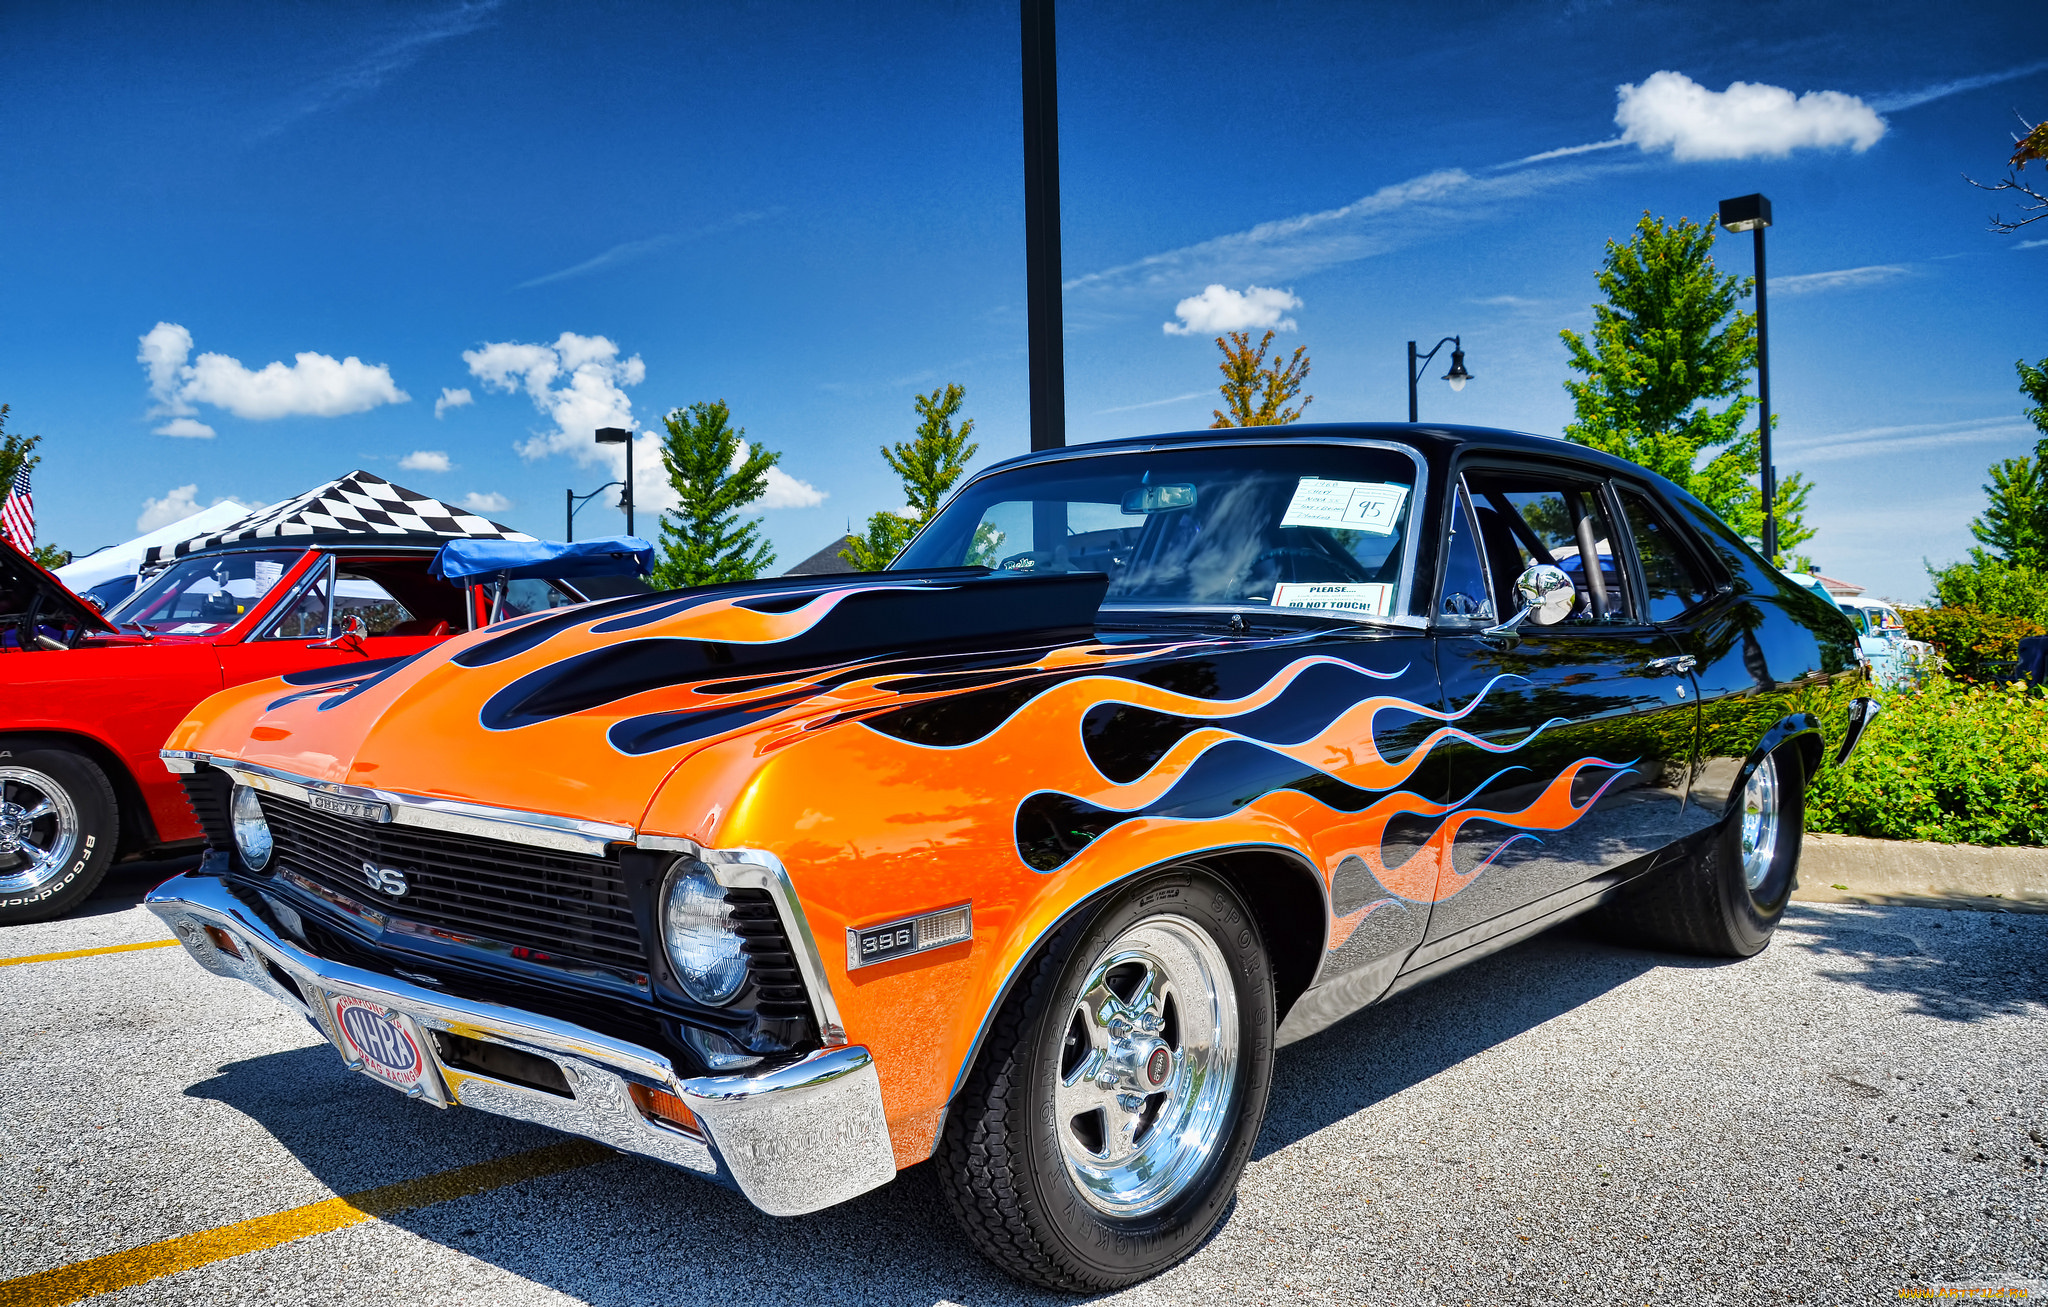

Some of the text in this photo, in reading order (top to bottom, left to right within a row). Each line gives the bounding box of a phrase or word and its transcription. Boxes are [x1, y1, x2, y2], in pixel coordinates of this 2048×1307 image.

[1358, 500, 1385, 519] 95
[1306, 601, 1329, 609] NOT
[1330, 601, 1371, 611] TOUCH!
[315, 797, 358, 815] CHEVY
[362, 862, 409, 897] SS
[862, 928, 911, 955] 396
[347, 1010, 413, 1067] NHRA
[358, 1048, 383, 1075] DRAG
[1039, 926, 1108, 1190] THOMPSON
